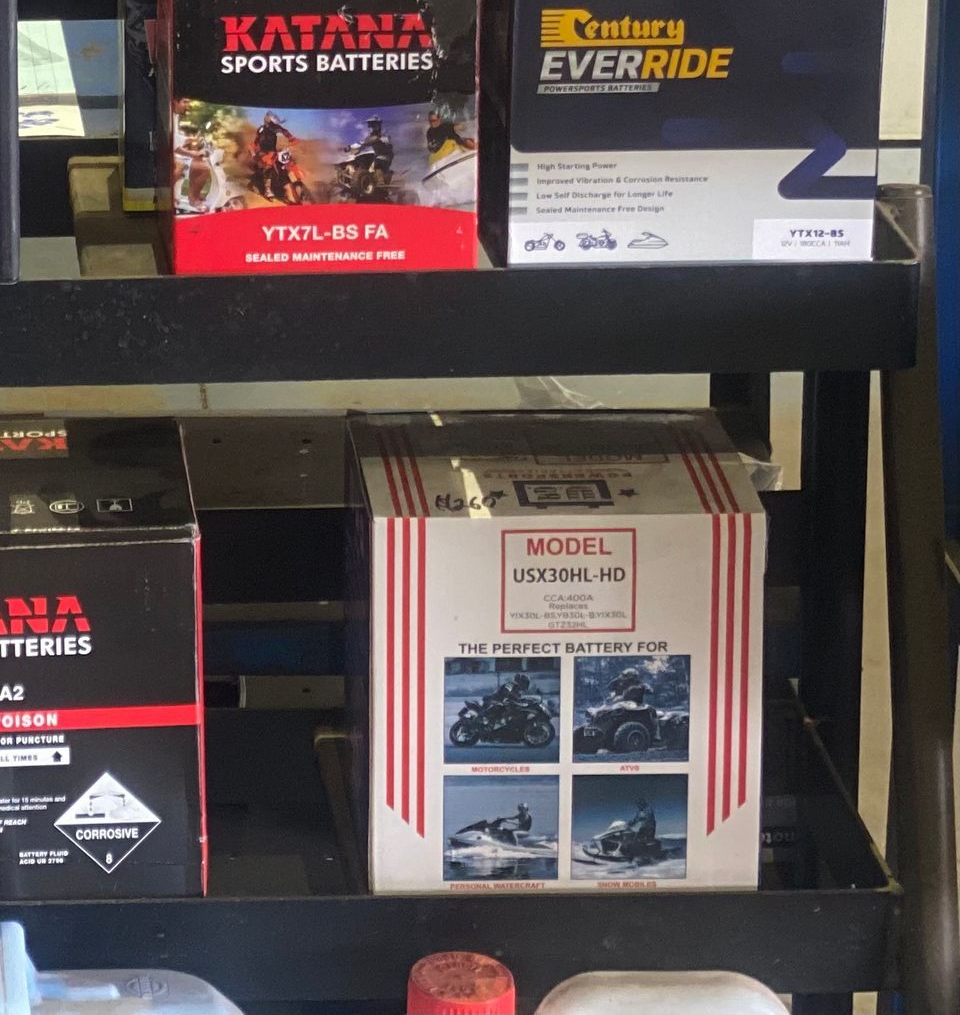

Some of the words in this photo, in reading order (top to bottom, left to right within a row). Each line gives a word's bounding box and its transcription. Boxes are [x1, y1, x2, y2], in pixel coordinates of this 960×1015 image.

[219, 13, 435, 52] KATANA
[540, 8, 686, 48] Century
[220, 55, 309, 74] SPORTS
[316, 52, 434, 73] BATTERIES
[540, 47, 735, 81] EVERRIDE
[543, 84, 606, 93] POWERSPORTS
[607, 83, 653, 92] BATTERIES
[537, 163, 556, 172] High
[558, 162, 590, 171] Starting
[592, 162, 618, 170] Power
[536, 177, 574, 186] Improved
[623, 176, 662, 184] Corrosion
[664, 175, 709, 183] Resistance
[571, 191, 612, 201] Discharge
[627, 191, 656, 199] Longer
[657, 190, 673, 198] Life
[536, 206, 563, 214] Sealed
[564, 206, 616, 214] Maintenance
[617, 205, 636, 213] Free
[637, 205, 664, 214] Design
[261, 224, 359, 243] YTX7L-BS
[363, 224, 390, 240] FA
[790, 229, 844, 238] YTX12-BS
[245, 251, 289, 264] SEALED
[292, 250, 374, 262] MAINTENANCE
[376, 250, 406, 261] FREE
[526, 537, 613, 556] MODEL
[513, 567, 626, 583] USX30HL-HD
[548, 602, 589, 611] Replaces
[458, 642, 487, 655] THE
[492, 642, 561, 655] PERFECT
[565, 641, 633, 654] BATTERY
[637, 641, 669, 653] FOR
[0, 736, 13, 746] OR
[15, 734, 65, 745] PUNCTURE
[12, 754, 39, 762] TIMES
[471, 766, 530, 774] MOTORCYCLES
[3, 818, 27, 826] REACH
[75, 827, 139, 841] CORROSIVE
[105, 851, 113, 865] 8
[450, 882, 491, 891] PERSONAL
[492, 882, 545, 891] WATERCRAFT
[597, 881, 621, 889] SNOW
[622, 881, 657, 889] MOBILES
